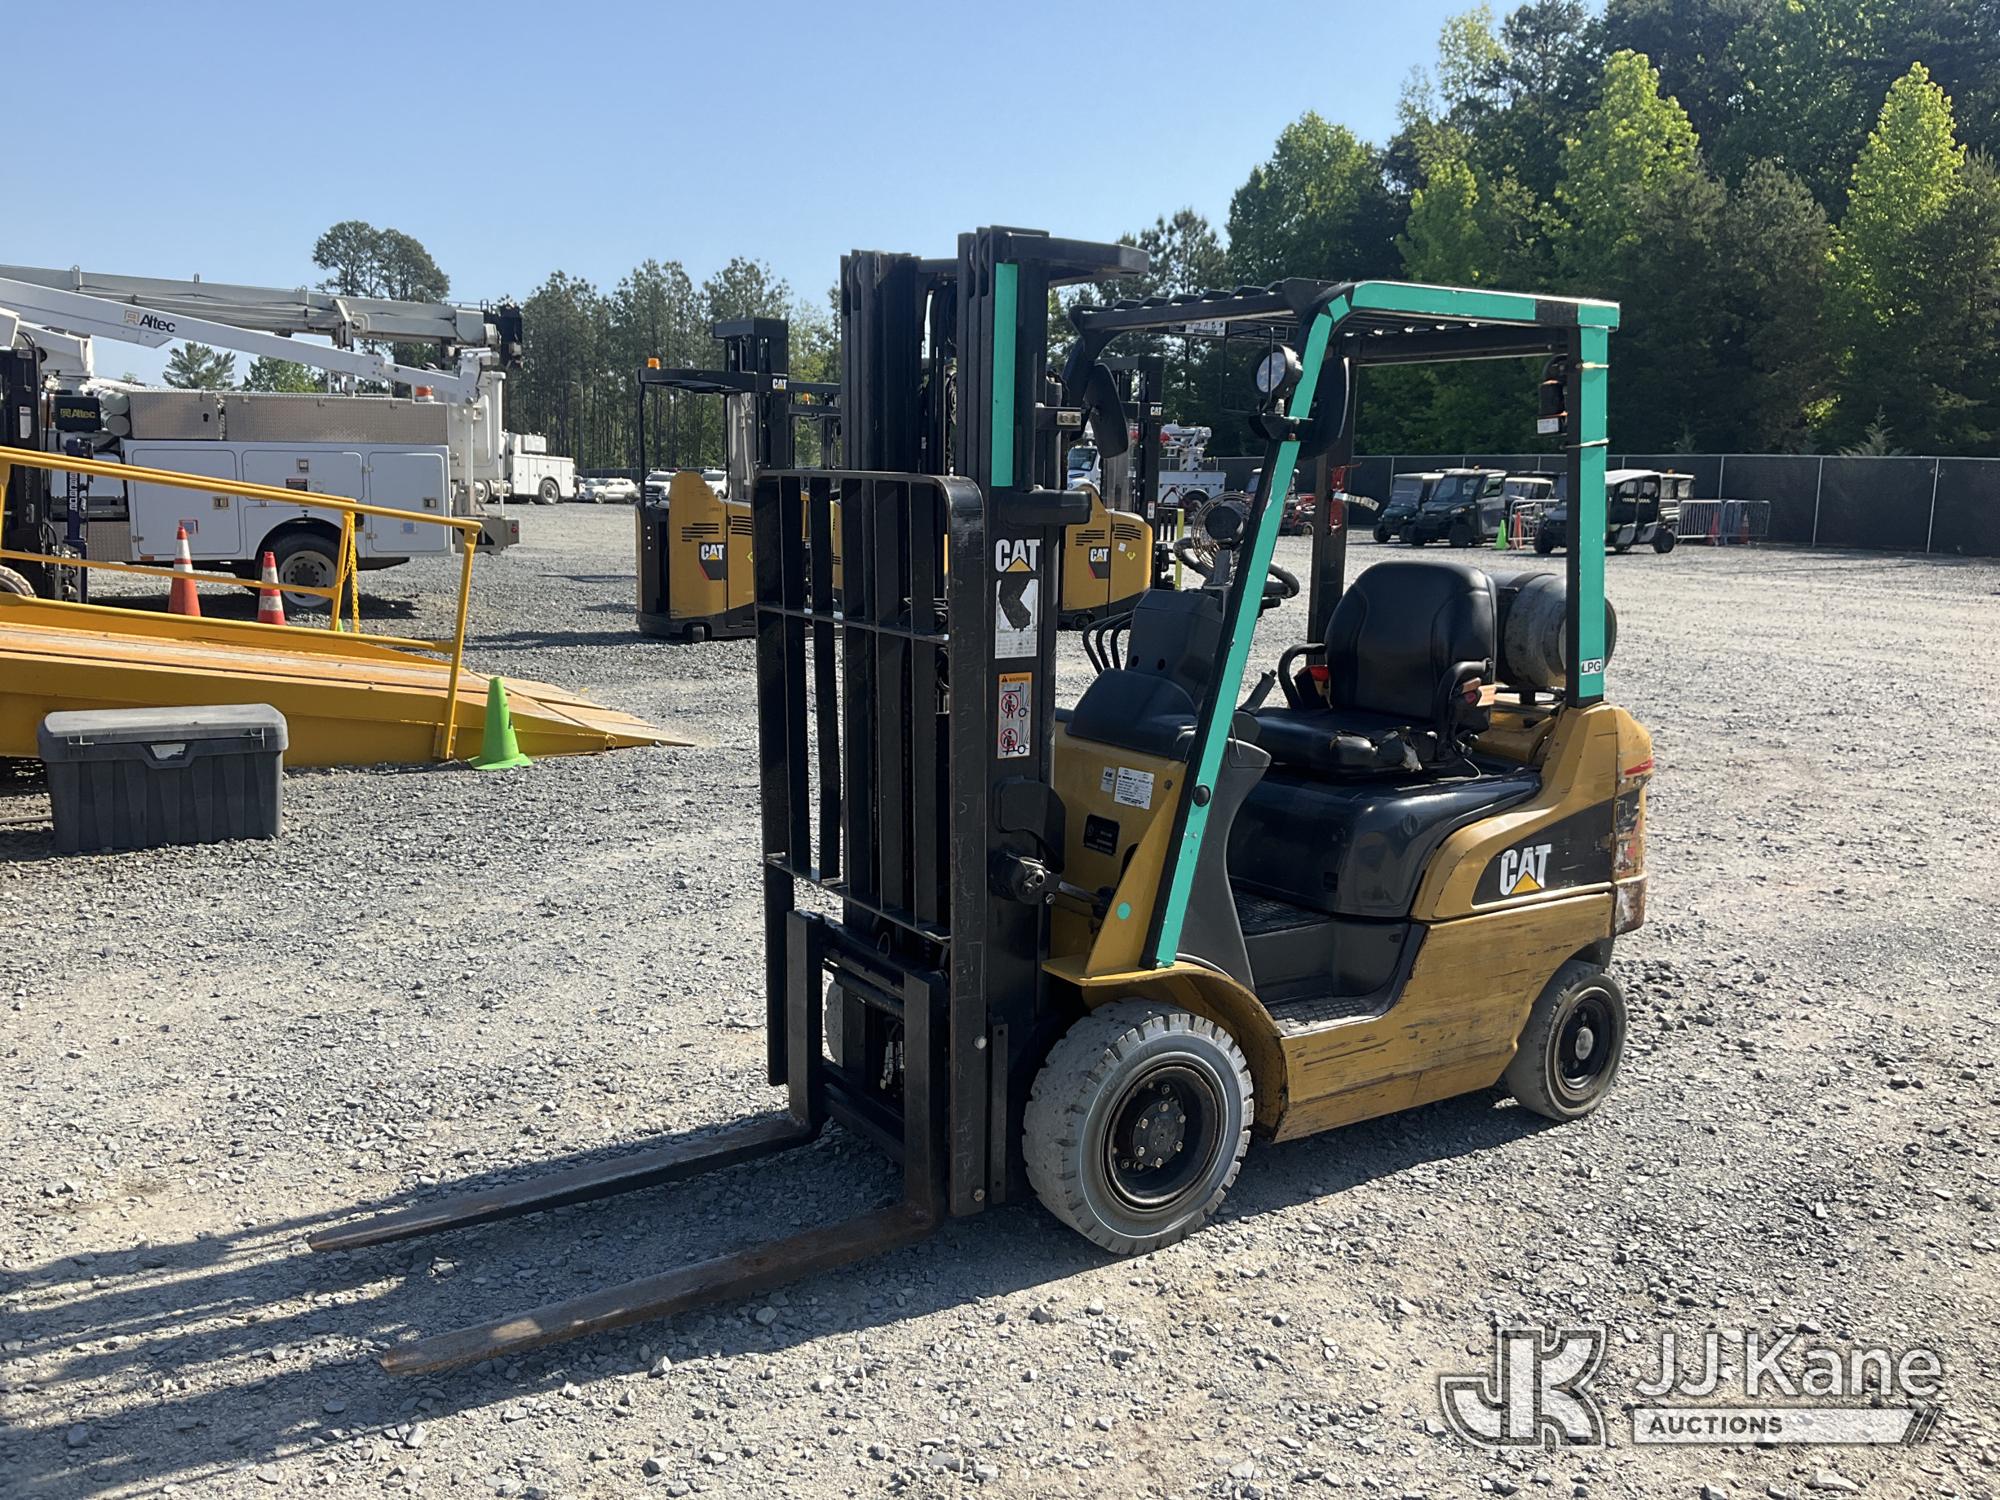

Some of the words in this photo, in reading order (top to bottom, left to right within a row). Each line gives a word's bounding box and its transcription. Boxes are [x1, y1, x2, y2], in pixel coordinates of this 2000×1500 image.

[139, 313, 176, 333] Altec
[772, 378, 788, 390] CAT
[1150, 406, 1163, 416] CAT
[701, 544, 725, 561] CAT
[995, 539, 1041, 572] CAT
[1090, 548, 1109, 562] CAT
[1581, 660, 1602, 673] LPG
[1500, 844, 1552, 895] CAT
